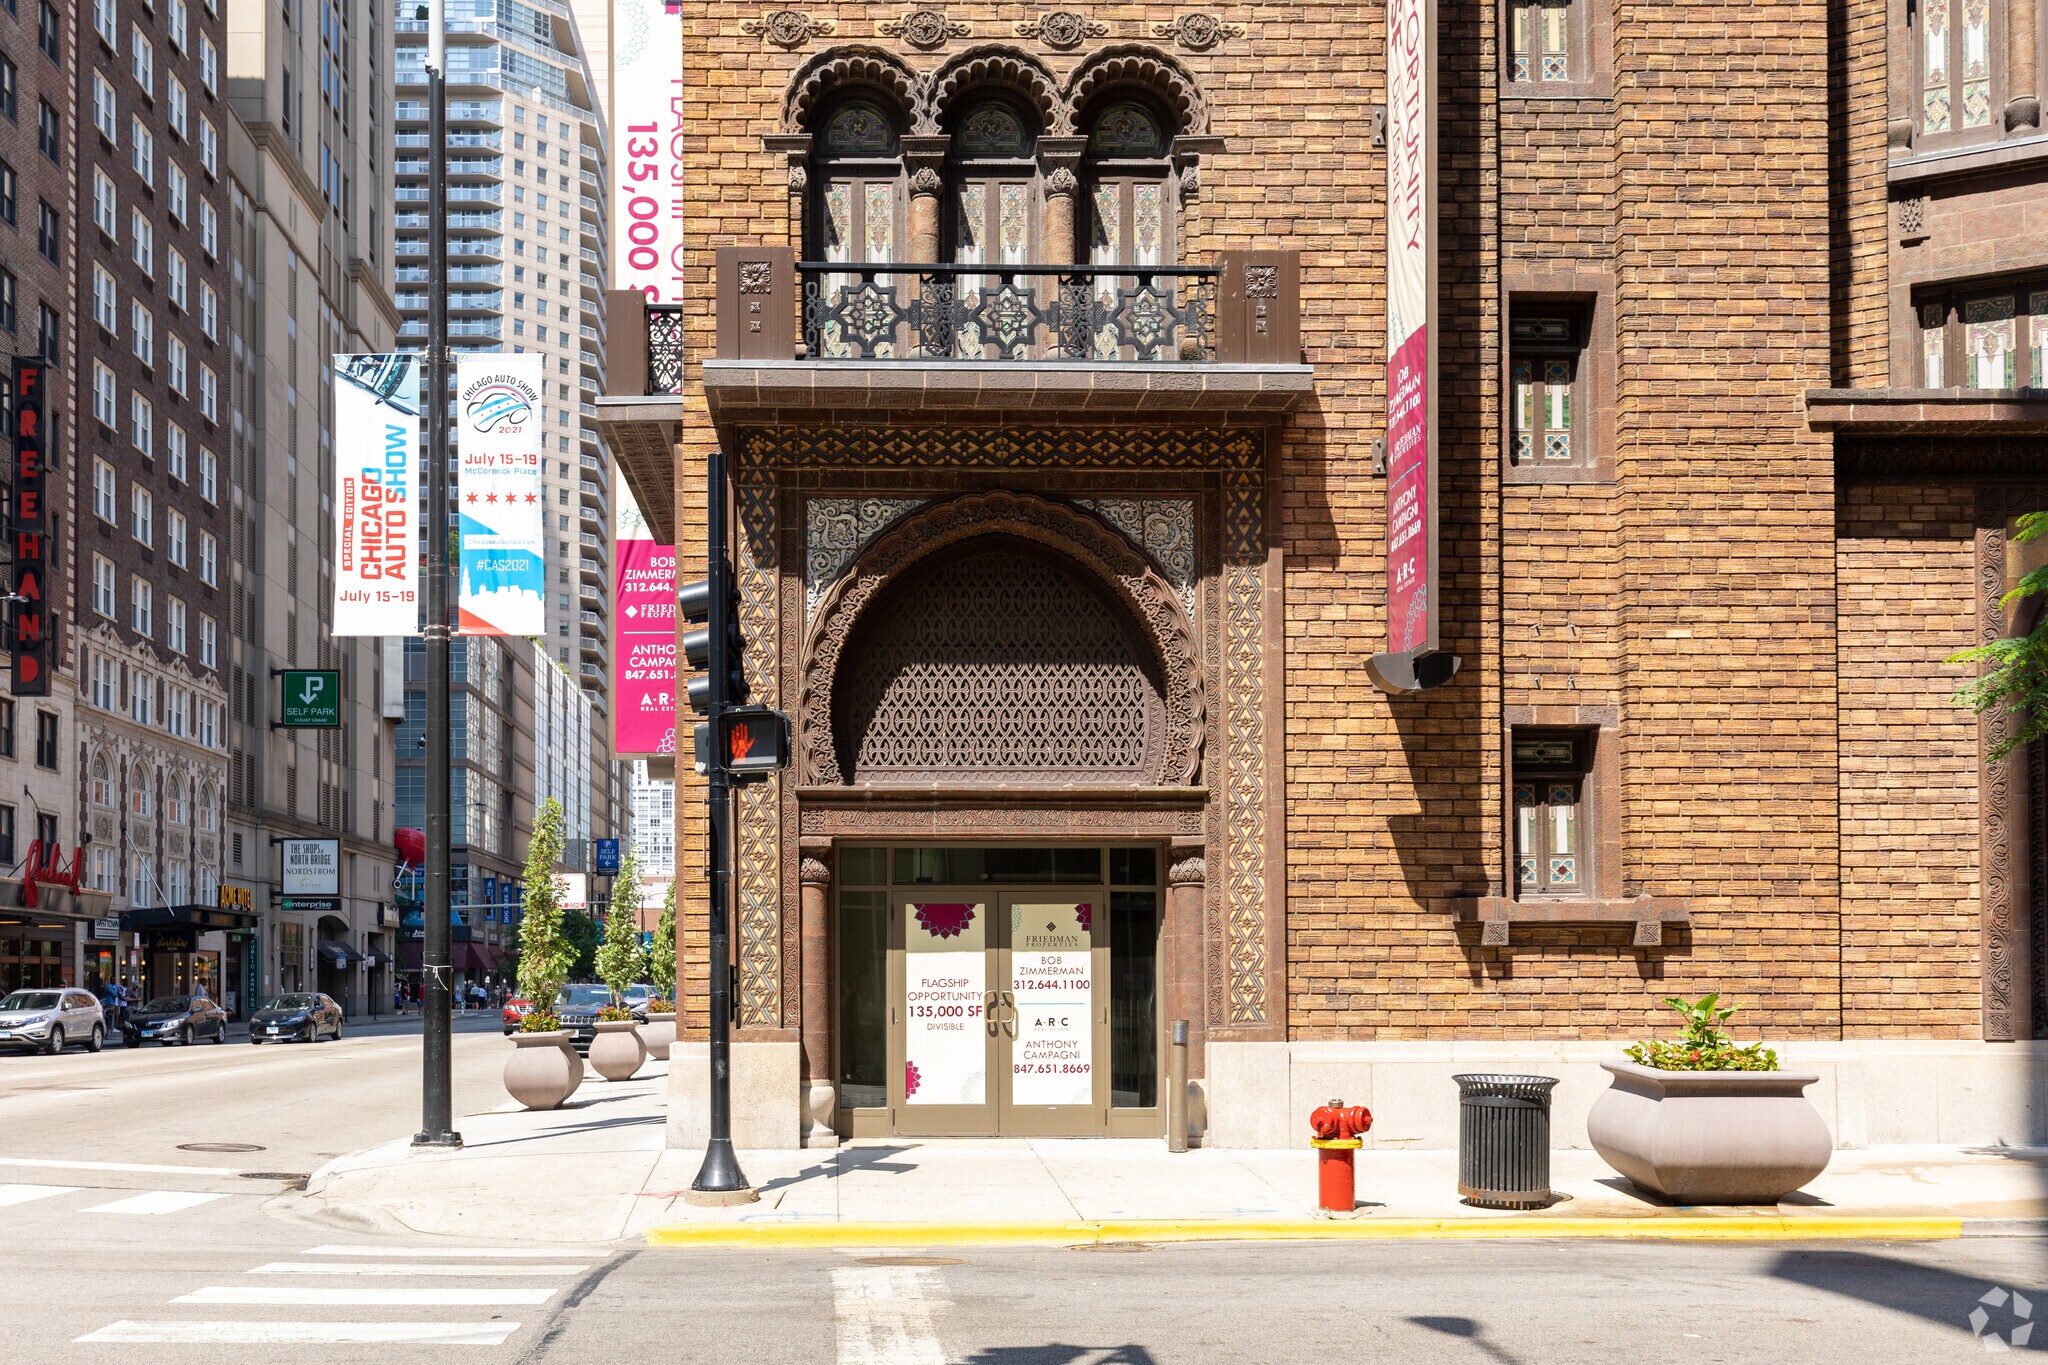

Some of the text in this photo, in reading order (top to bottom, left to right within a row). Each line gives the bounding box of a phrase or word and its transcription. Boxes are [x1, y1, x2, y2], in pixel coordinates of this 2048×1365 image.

[1406, 0, 1420, 250] ORTUNITY
[622, 121, 659, 271] 135,000
[462, 374, 539, 402] CHICAGO AUTO SHOW
[498, 426, 523, 434] 2021
[465, 453, 495, 467] July
[464, 467, 537, 476] McCormick Place
[385, 424, 407, 580] AUTO SHOW
[18, 368, 40, 683] FREEHAND
[344, 480, 354, 567] SPECIAL EDITION
[360, 467, 382, 580] CHICAGO
[476, 559, 529, 572] #CAS2021
[650, 556, 676, 568] BOB
[340, 590, 371, 604] July
[632, 644, 676, 655] ANTHO
[625, 669, 676, 680] 847.651.
[286, 707, 335, 716] SELF PARK
[290, 843, 301, 855] THE
[302, 843, 320, 855] SHOPS
[290, 854, 331, 866] NORTH BRIDGE
[285, 867, 336, 875] NORDSTROM
[283, 900, 332, 909] enterprise
[1025, 935, 1079, 943] FRIEDMAN
[1041, 955, 1063, 965] BOB
[1019, 966, 1084, 976] ZIMMERMAN
[921, 978, 969, 988] FLAGSHIP
[1013, 979, 1091, 990] 312.644.1100
[907, 991, 983, 1001] OPPORTUNITY
[909, 1005, 983, 1019] 135,000 SF
[926, 1022, 965, 1031] DIVISIBLE
[1025, 1039, 1078, 1049] ANTHONY
[1023, 1050, 1080, 1060] CAMPAGNI
[1013, 1063, 1091, 1074] 847.651.8669
